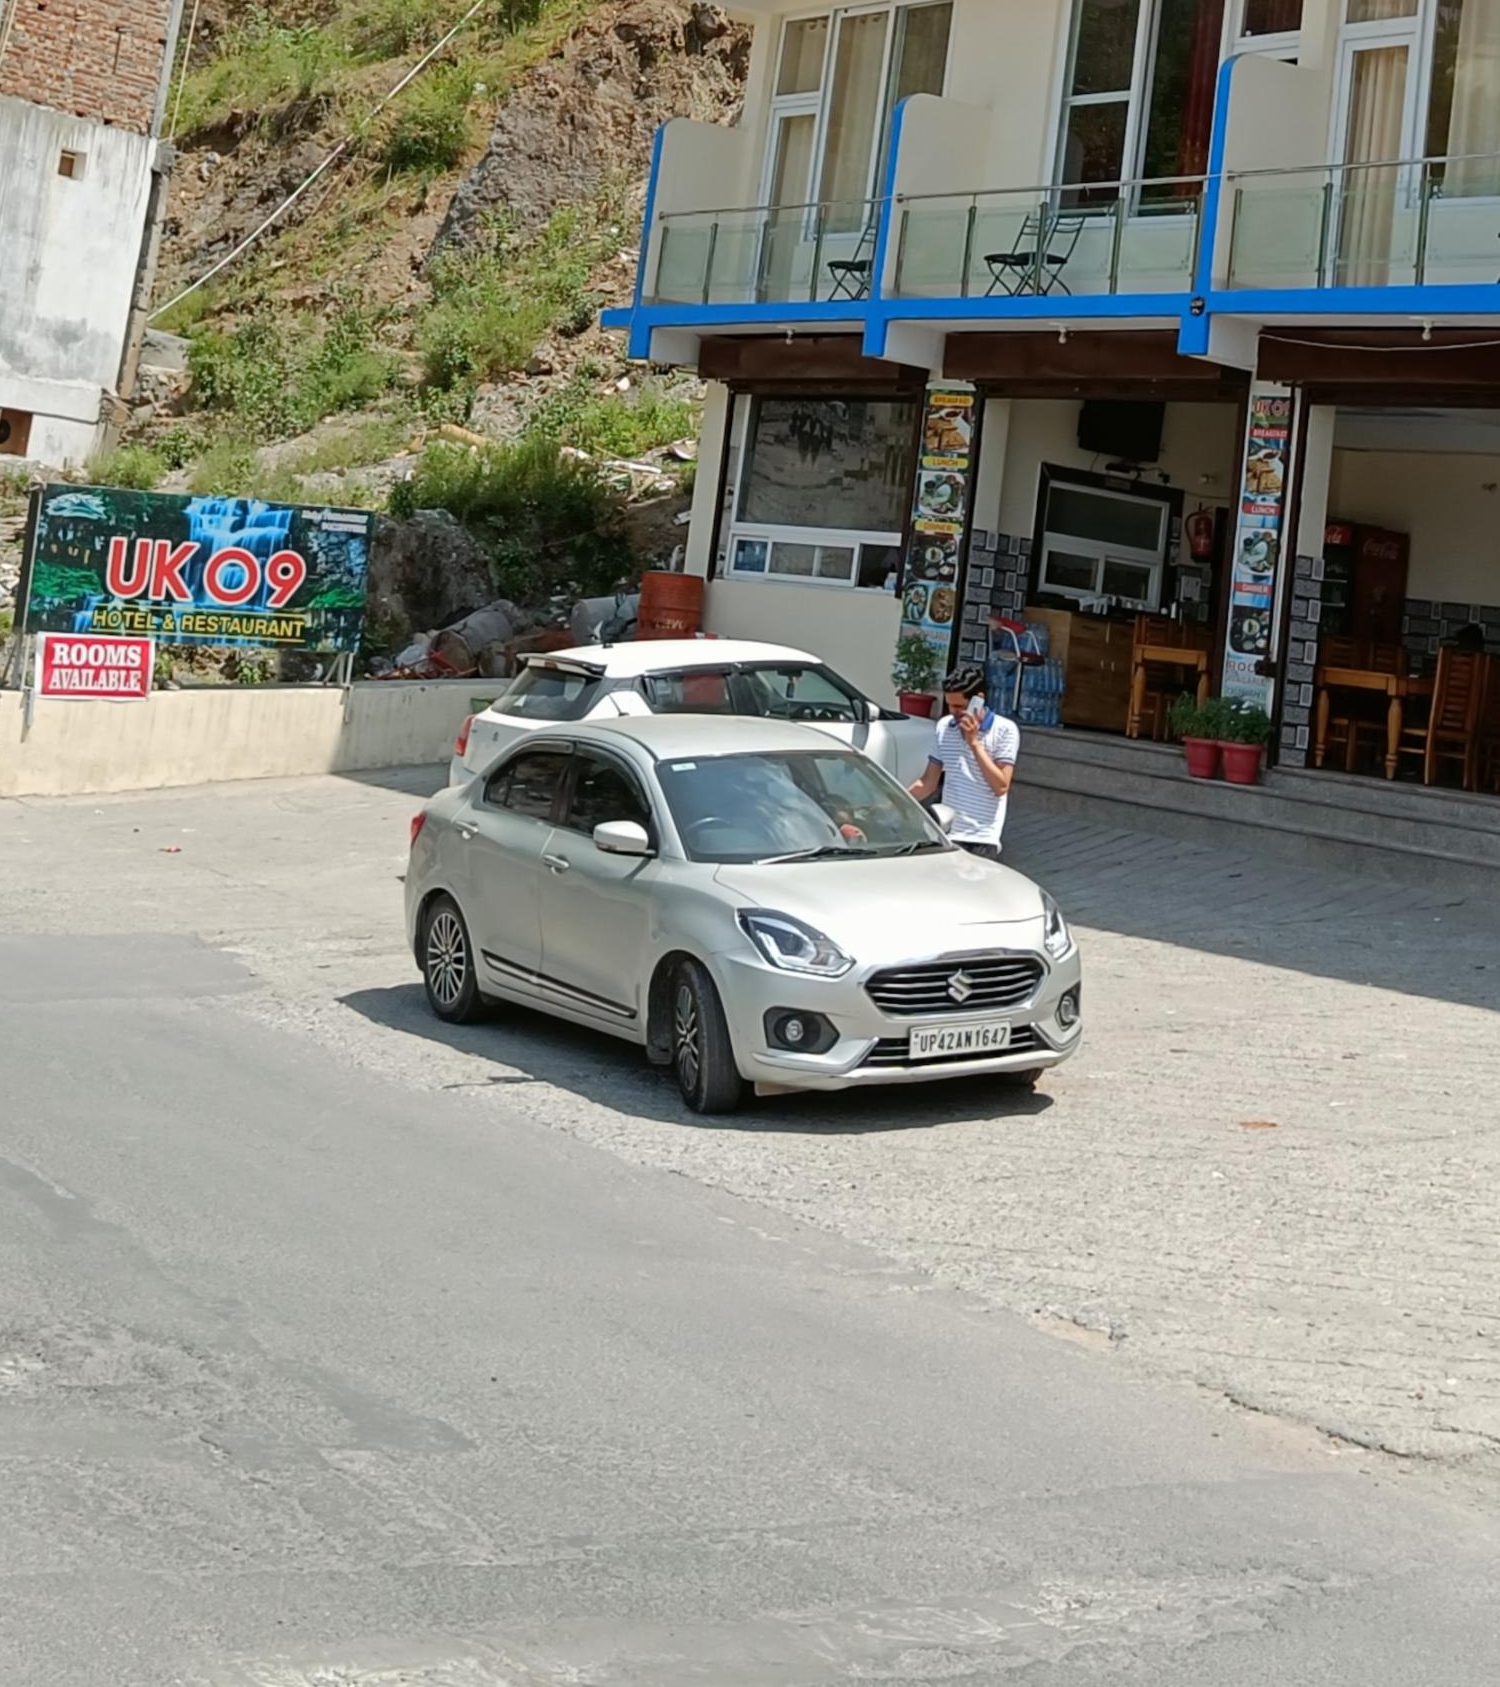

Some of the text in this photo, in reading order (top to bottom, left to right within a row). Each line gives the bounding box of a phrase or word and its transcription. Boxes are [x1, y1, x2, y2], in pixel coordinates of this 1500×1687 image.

[105, 536, 200, 602] UK
[92, 611, 305, 639] HOTEL & RESTAURANT
[51, 642, 142, 667] ROOMS
[48, 667, 141, 693] AVAILABLE
[919, 1028, 1008, 1053] UP42AN1647
